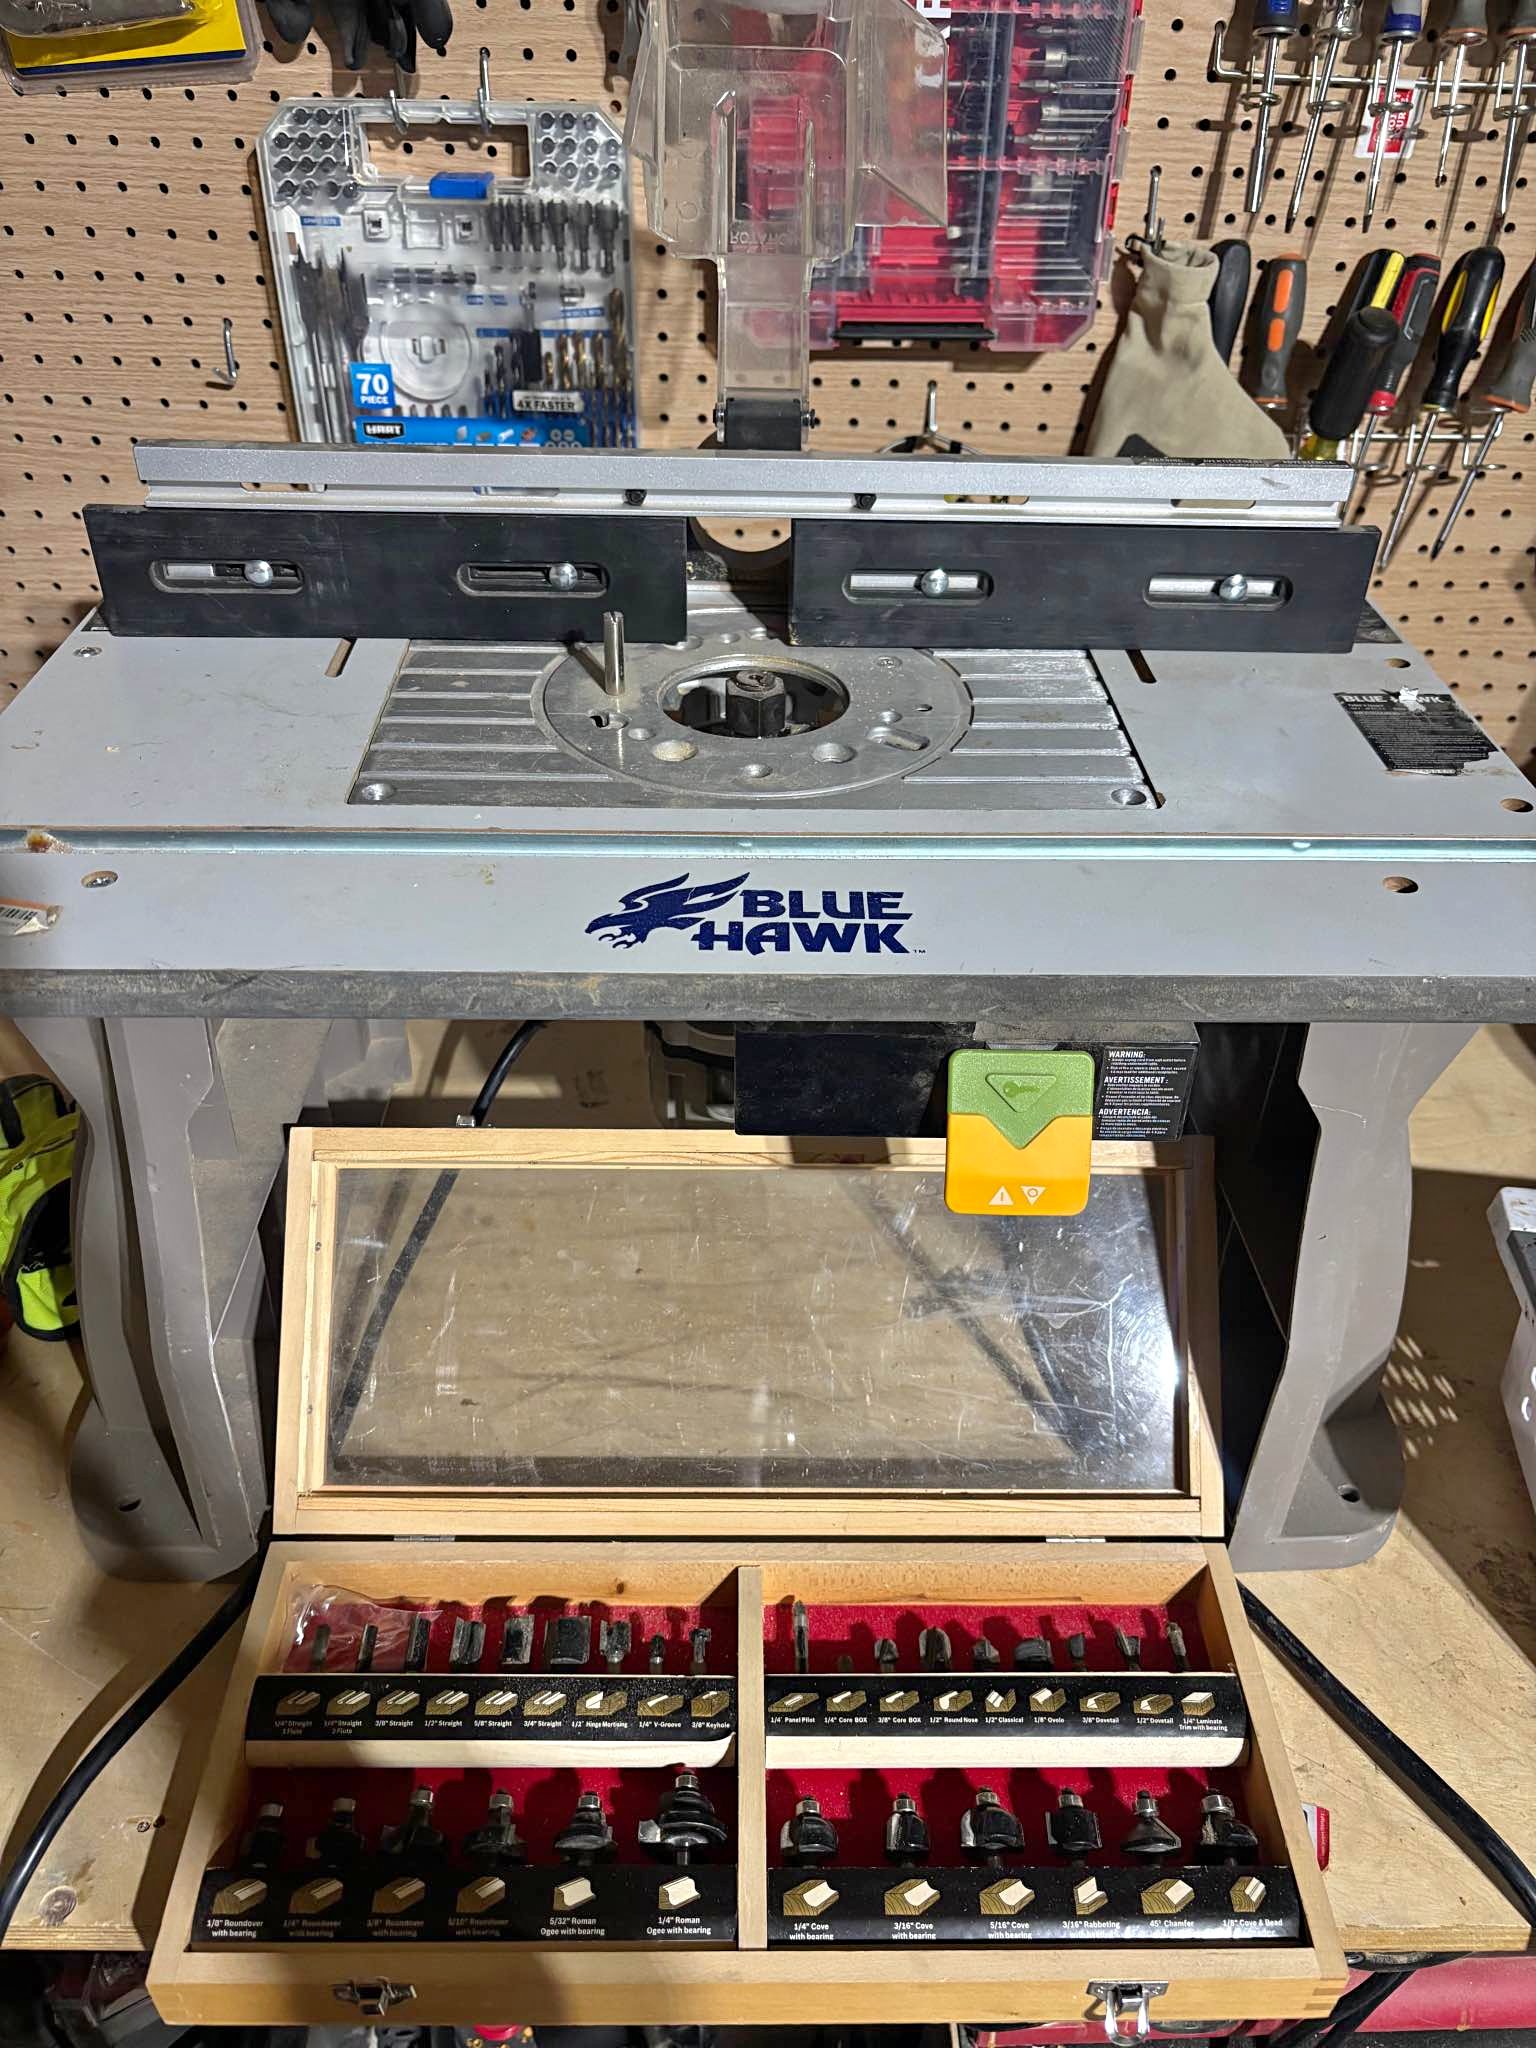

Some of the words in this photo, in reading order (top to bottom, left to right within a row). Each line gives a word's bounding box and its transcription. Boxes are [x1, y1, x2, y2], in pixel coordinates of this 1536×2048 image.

[356, 373, 389, 395] 70
[360, 395, 389, 404] PIECE
[517, 400, 532, 408] 4X
[534, 400, 576, 410] FASTER
[739, 889, 913, 920] BLUE
[691, 921, 910, 955] HAWK
[1098, 1108, 1151, 1116] ADVERTENCIA:
[1083, 1920, 1120, 1929] Rabbeting
[229, 1930, 256, 1938] bearing
[540, 1928, 559, 1936] Ogee
[577, 1928, 605, 1936] bearing
[646, 1927, 665, 1935] Ogee
[684, 1927, 711, 1935] bearing
[806, 1932, 834, 1940] bearing
[909, 1932, 936, 1940] bearing
